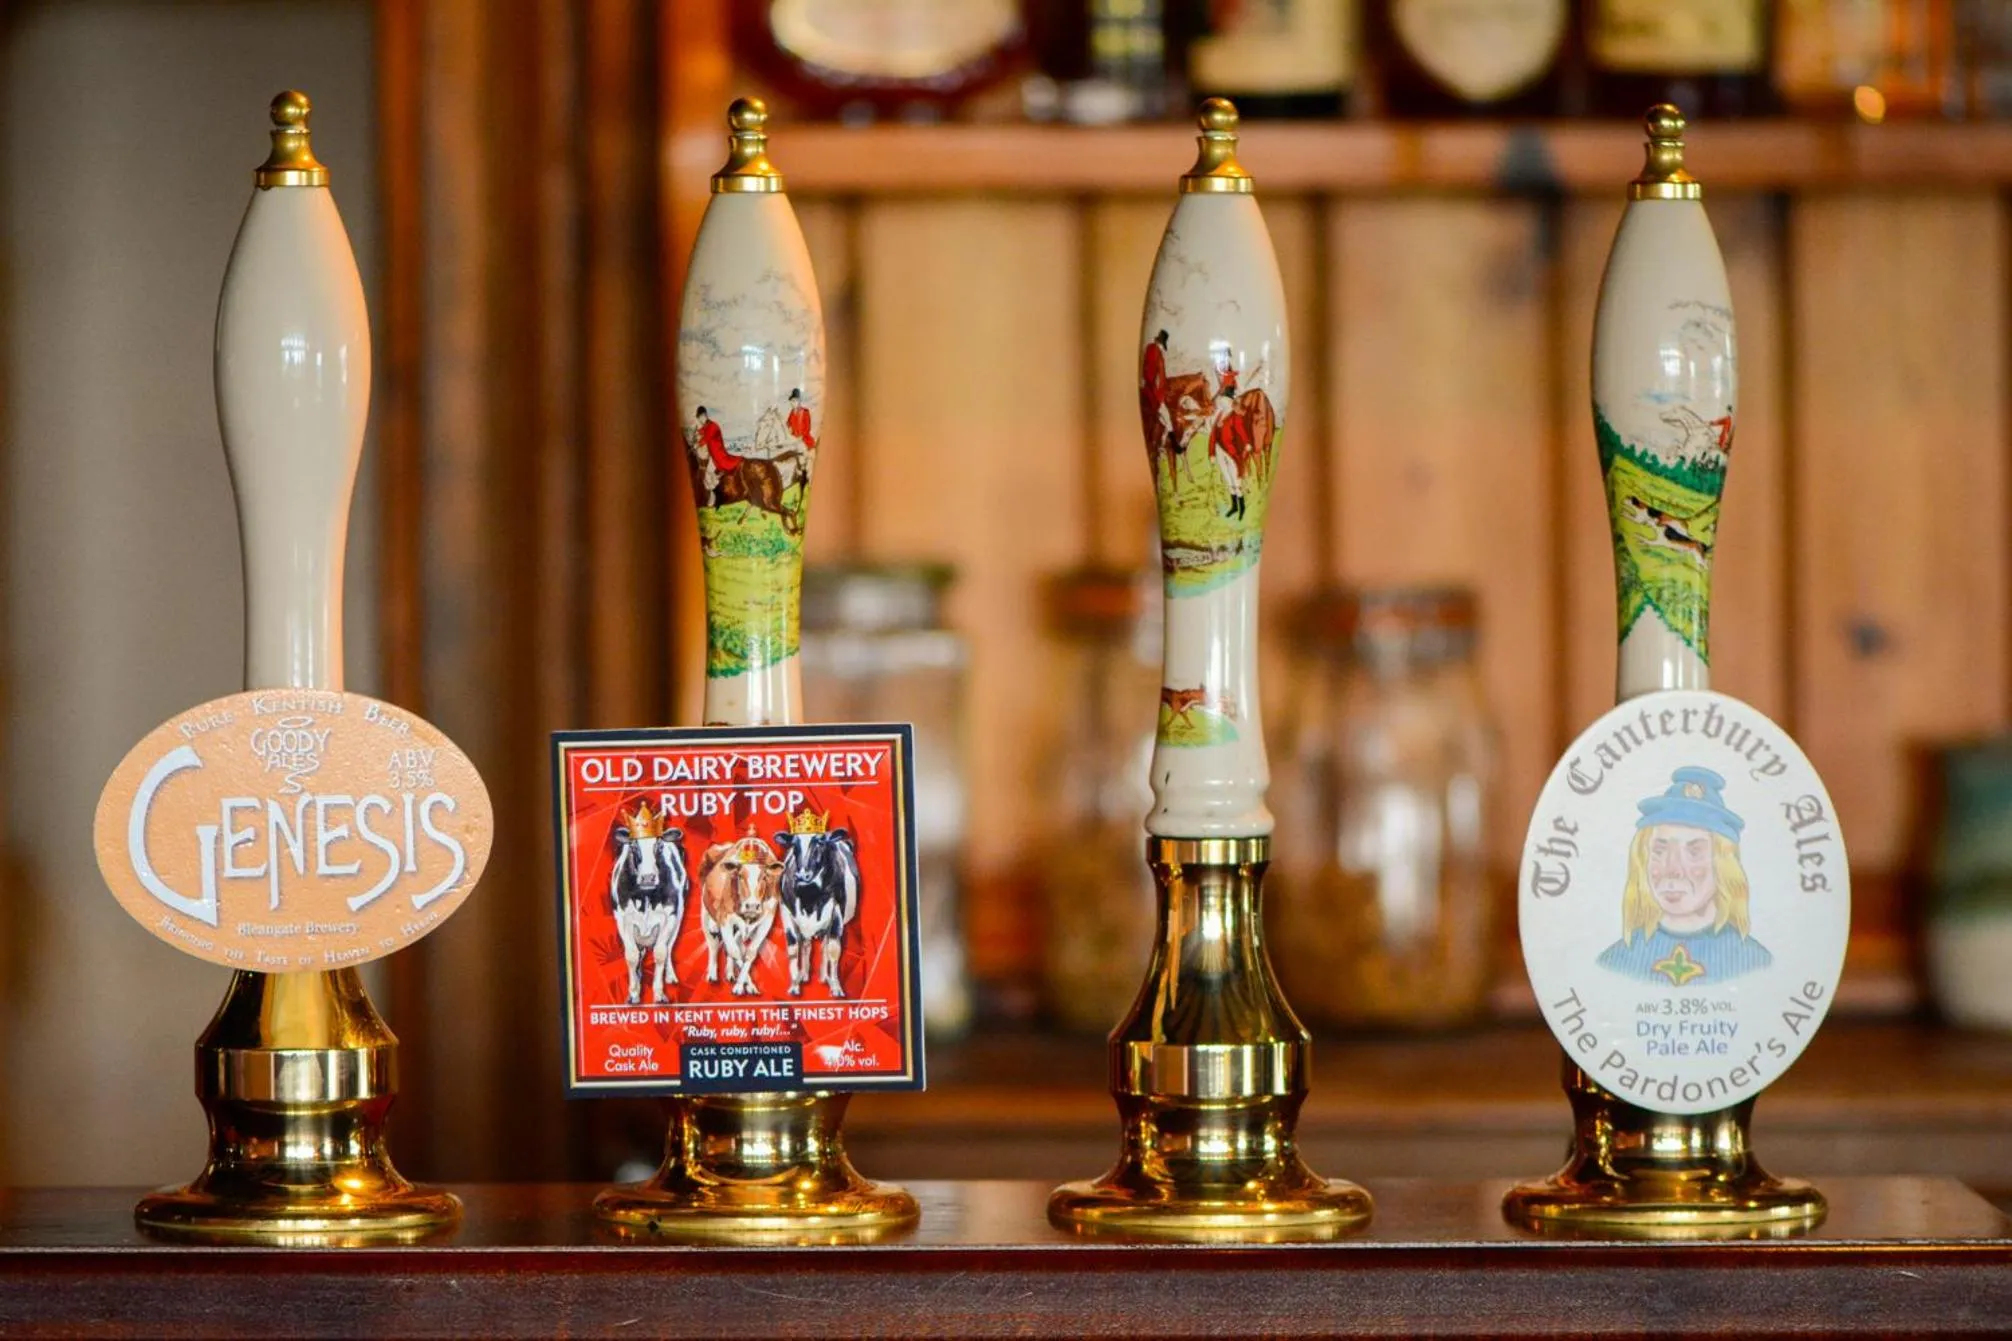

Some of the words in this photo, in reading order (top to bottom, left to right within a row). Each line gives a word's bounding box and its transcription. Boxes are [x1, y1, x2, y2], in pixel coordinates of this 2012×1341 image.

[250, 727, 332, 757] GOODY
[387, 748, 436, 770] ABV
[580, 758, 644, 784] OLD
[653, 754, 739, 782] DAIRY
[748, 750, 884, 779] BREWERY
[661, 792, 737, 817] RUBY
[744, 790, 804, 814] TOP
[1530, 815, 1580, 900] The
[1565, 702, 1788, 796] Canterbury
[1780, 793, 1833, 895] Ales
[128, 745, 466, 927] GENESIS
[305, 921, 358, 936] Brewery
[590, 1011, 650, 1025] BREWED
[654, 1010, 670, 1024] IN
[674, 1010, 714, 1024] KENT
[717, 1009, 757, 1023] WITH
[760, 1008, 790, 1021] THE
[794, 1007, 845, 1021] FINEST
[848, 1006, 890, 1020] HOPS
[1636, 1002, 1659, 1014] ABV
[1662, 998, 1709, 1015] 3.8%
[720, 1025, 748, 1038] ruby,
[1636, 1020, 1672, 1039] Dry
[1679, 1019, 1739, 1038] Fruity
[690, 1046, 717, 1056] CASK
[720, 1045, 792, 1056] CONDITIONED
[841, 1039, 865, 1053] Alc.
[1553, 987, 1598, 1054] The
[1599, 1041, 1787, 1103] Pardoner's
[1781, 980, 1825, 1036] Ale
[1646, 1038, 1690, 1056] Pale
[1695, 1038, 1729, 1056] Ale
[608, 1044, 655, 1061] Quality
[858, 1054, 880, 1067] vol.
[604, 1060, 635, 1072] Cask
[638, 1060, 660, 1072] Ale
[688, 1060, 750, 1079] RUBY
[753, 1057, 795, 1078] ALE
